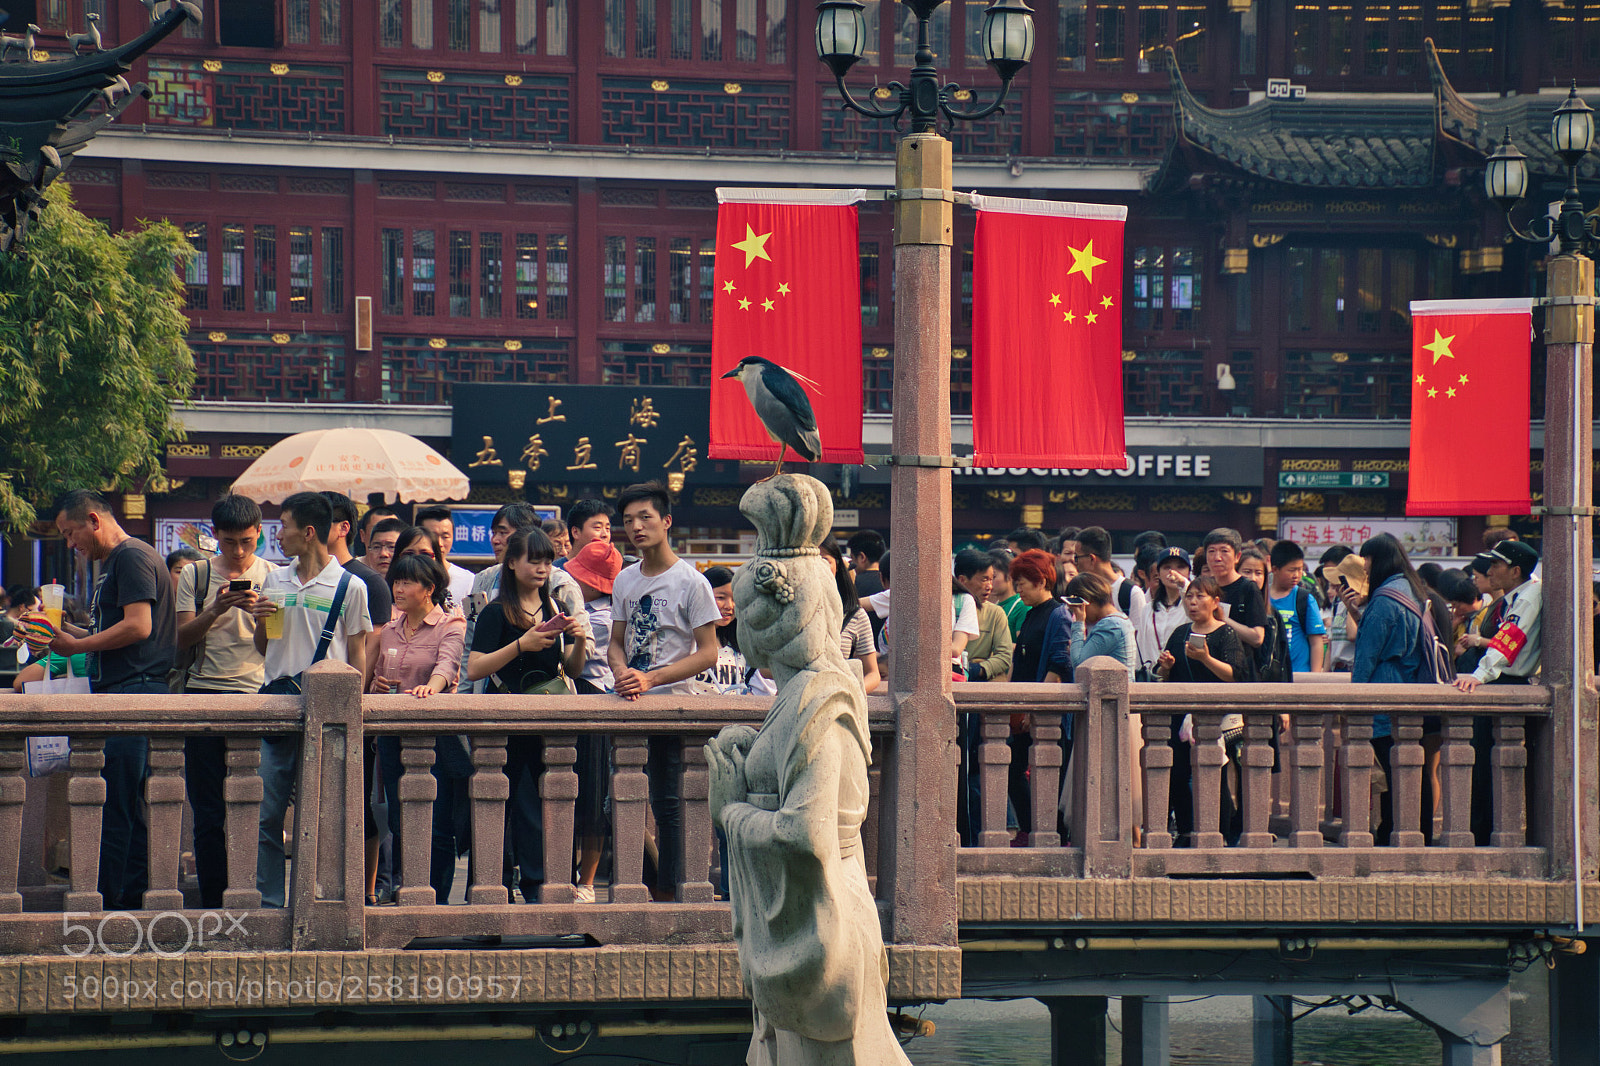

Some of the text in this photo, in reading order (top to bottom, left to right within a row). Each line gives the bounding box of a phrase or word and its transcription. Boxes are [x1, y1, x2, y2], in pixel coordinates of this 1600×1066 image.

[536, 395, 661, 428] 上海
[468, 432, 698, 473] 五香豆商店
[455, 525, 492, 542] 曲桥
